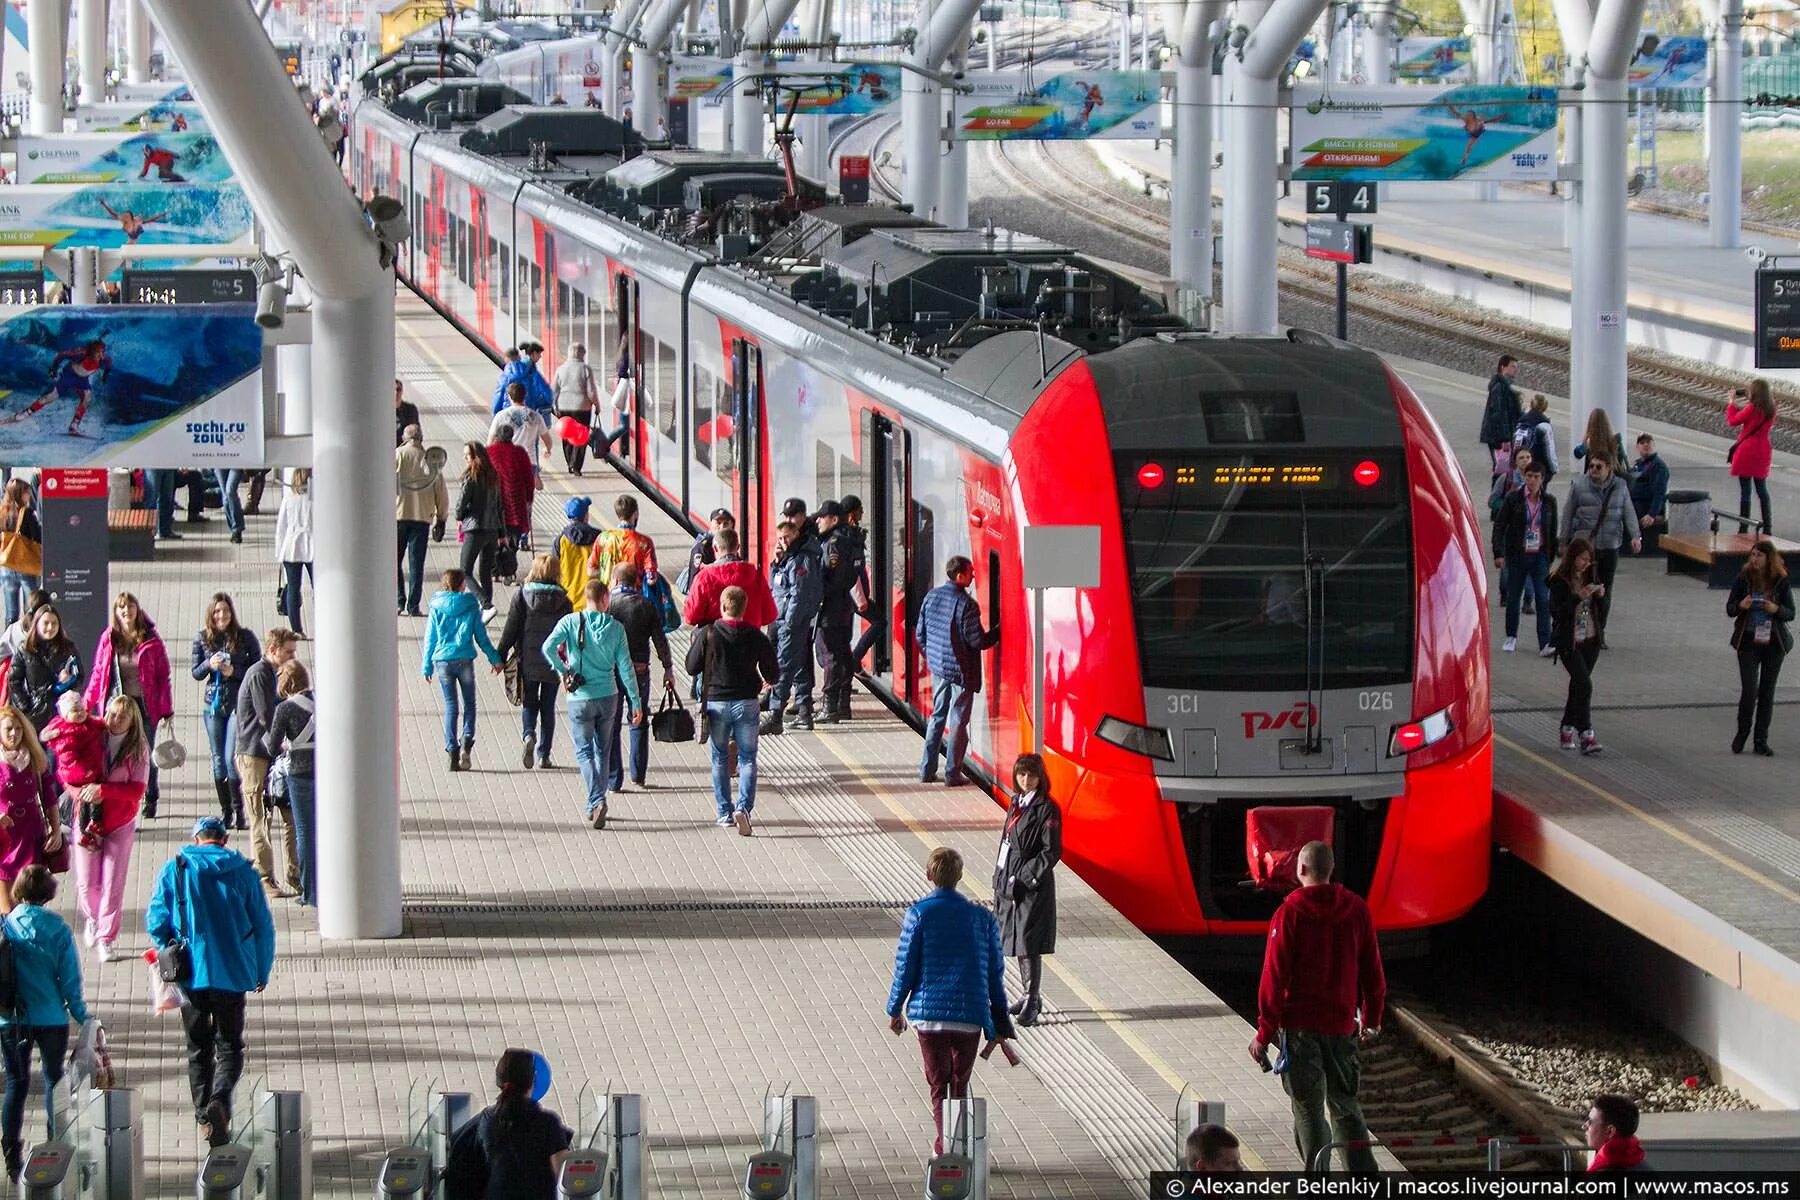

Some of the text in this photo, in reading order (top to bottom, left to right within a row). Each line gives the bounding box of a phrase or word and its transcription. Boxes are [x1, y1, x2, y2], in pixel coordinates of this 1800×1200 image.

[1323, 153, 1381, 162] ОТКРЫТИЯМ!
[1511, 151, 1549, 161] sochi.ru
[1315, 186, 1331, 210] 5
[1353, 186, 1370, 209] 4
[233, 280, 243, 295] 5
[1774, 279, 1785, 296] 5
[186, 420, 245, 433] sochi.ru
[193, 433, 224, 446] 2014
[1359, 691, 1393, 711] 026
